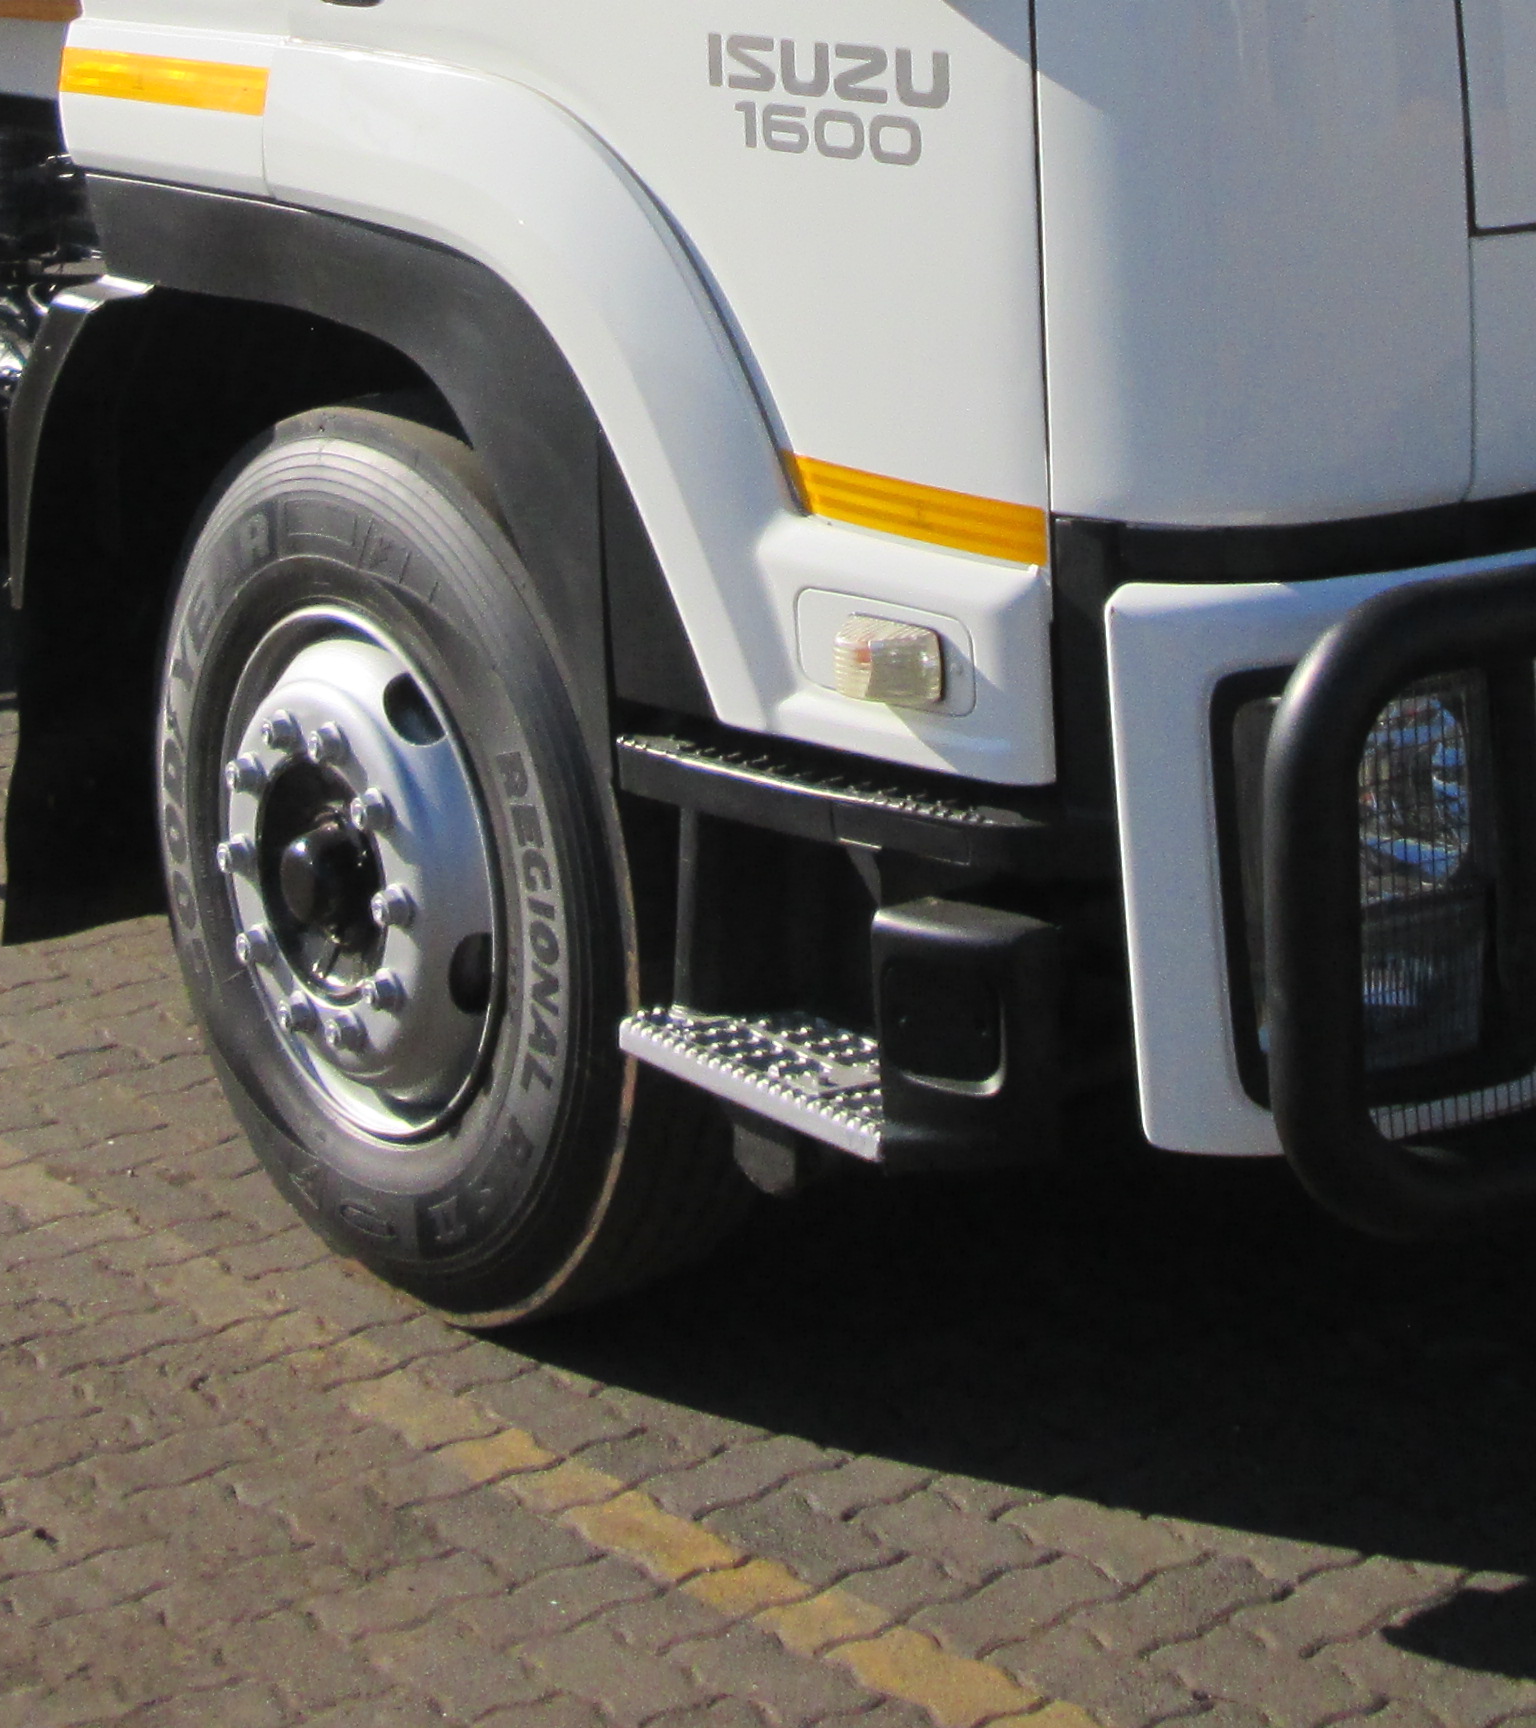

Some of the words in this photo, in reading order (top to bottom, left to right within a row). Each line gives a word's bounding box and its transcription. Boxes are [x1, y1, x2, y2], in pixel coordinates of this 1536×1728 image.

[706, 32, 951, 110] ISUZU
[733, 100, 923, 166] 1600
[495, 751, 562, 1093] REGIONAL
